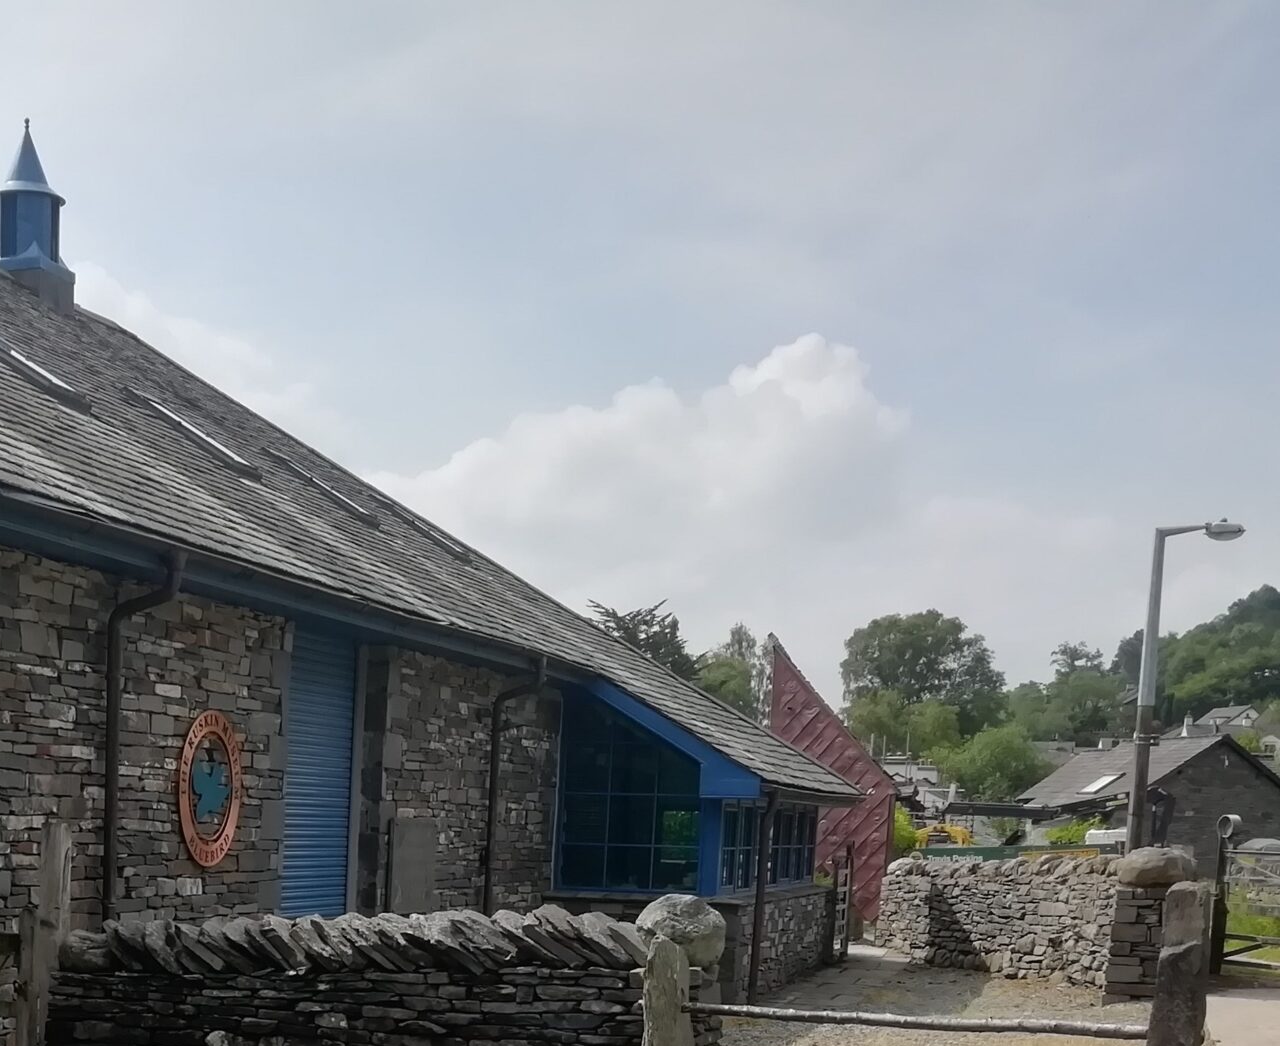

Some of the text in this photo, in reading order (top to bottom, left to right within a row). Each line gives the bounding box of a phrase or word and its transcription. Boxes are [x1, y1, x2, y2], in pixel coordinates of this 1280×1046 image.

[187, 713, 219, 750] RUSKIN
[221, 721, 240, 800] MUSEUM
[189, 833, 230, 863] BLUEBIRD
